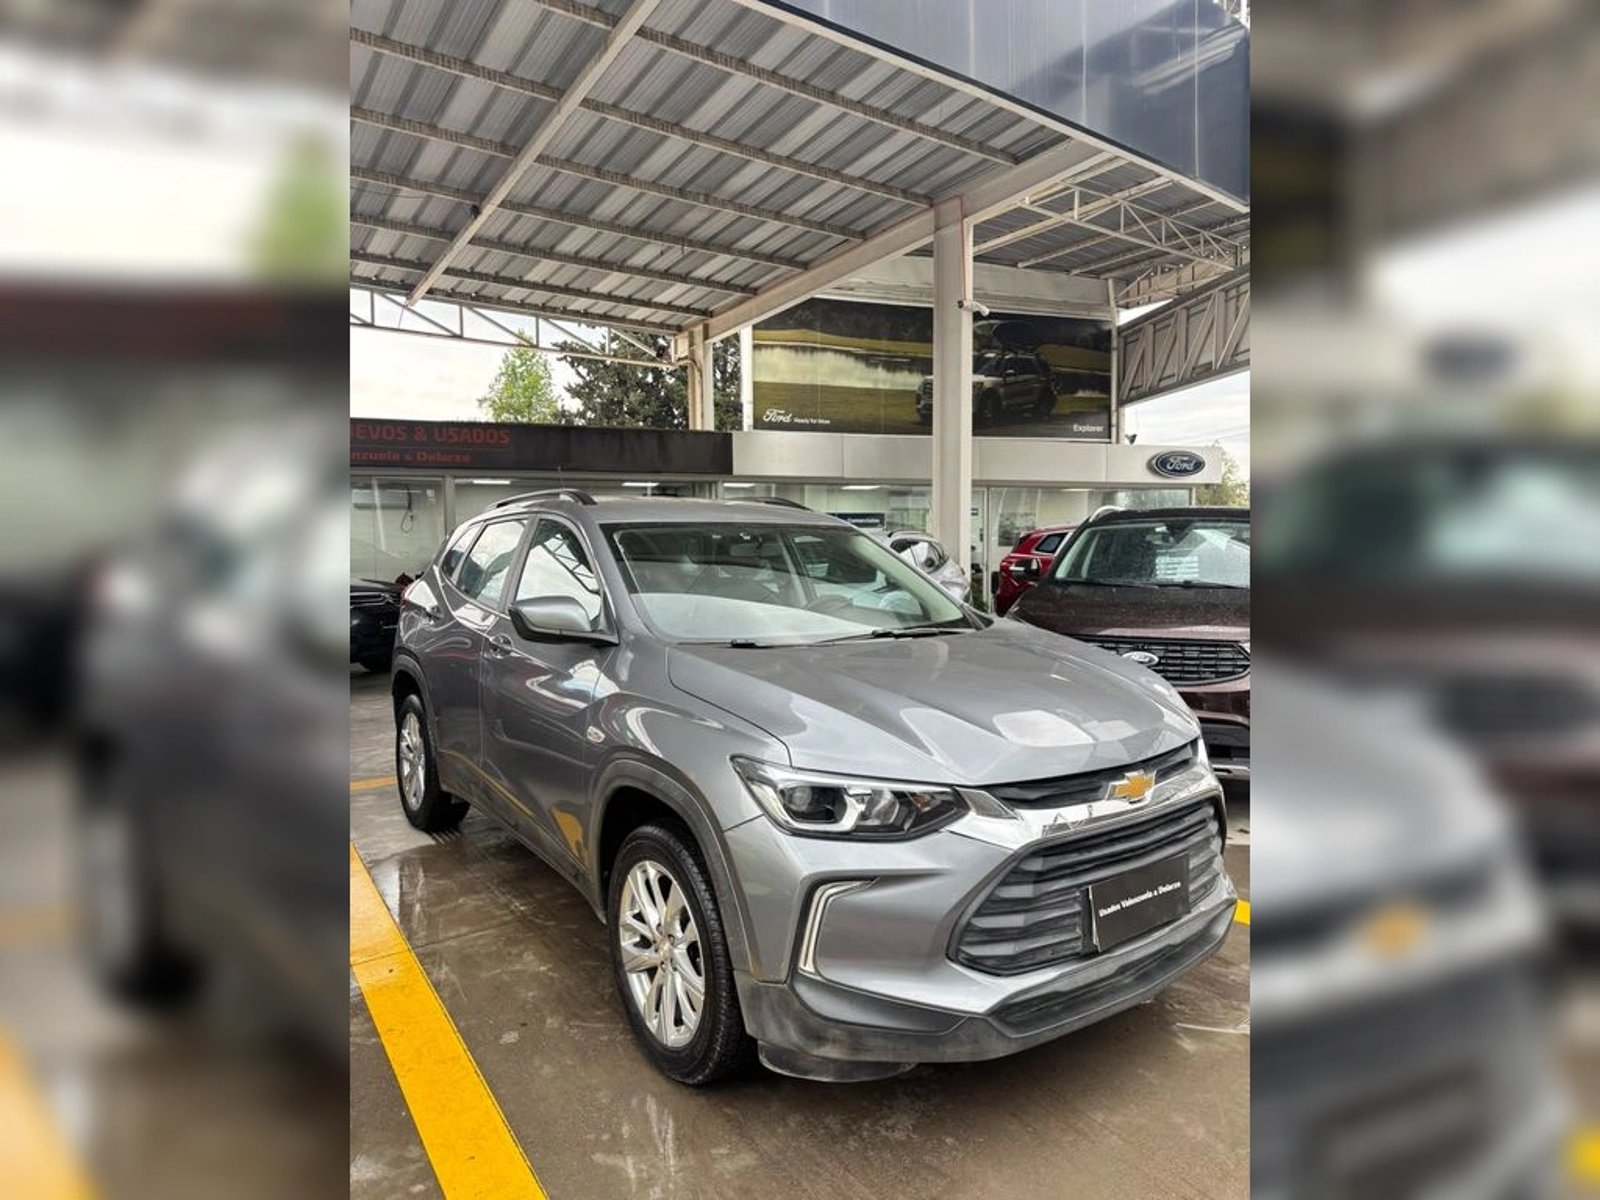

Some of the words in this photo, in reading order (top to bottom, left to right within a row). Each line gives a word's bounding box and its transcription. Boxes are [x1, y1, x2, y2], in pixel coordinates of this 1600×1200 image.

[763, 409, 792, 423] Ford
[413, 425, 428, 442] &
[434, 427, 510, 445] USADOS
[1073, 424, 1104, 433] Explorer
[1166, 456, 1195, 471] Ford
